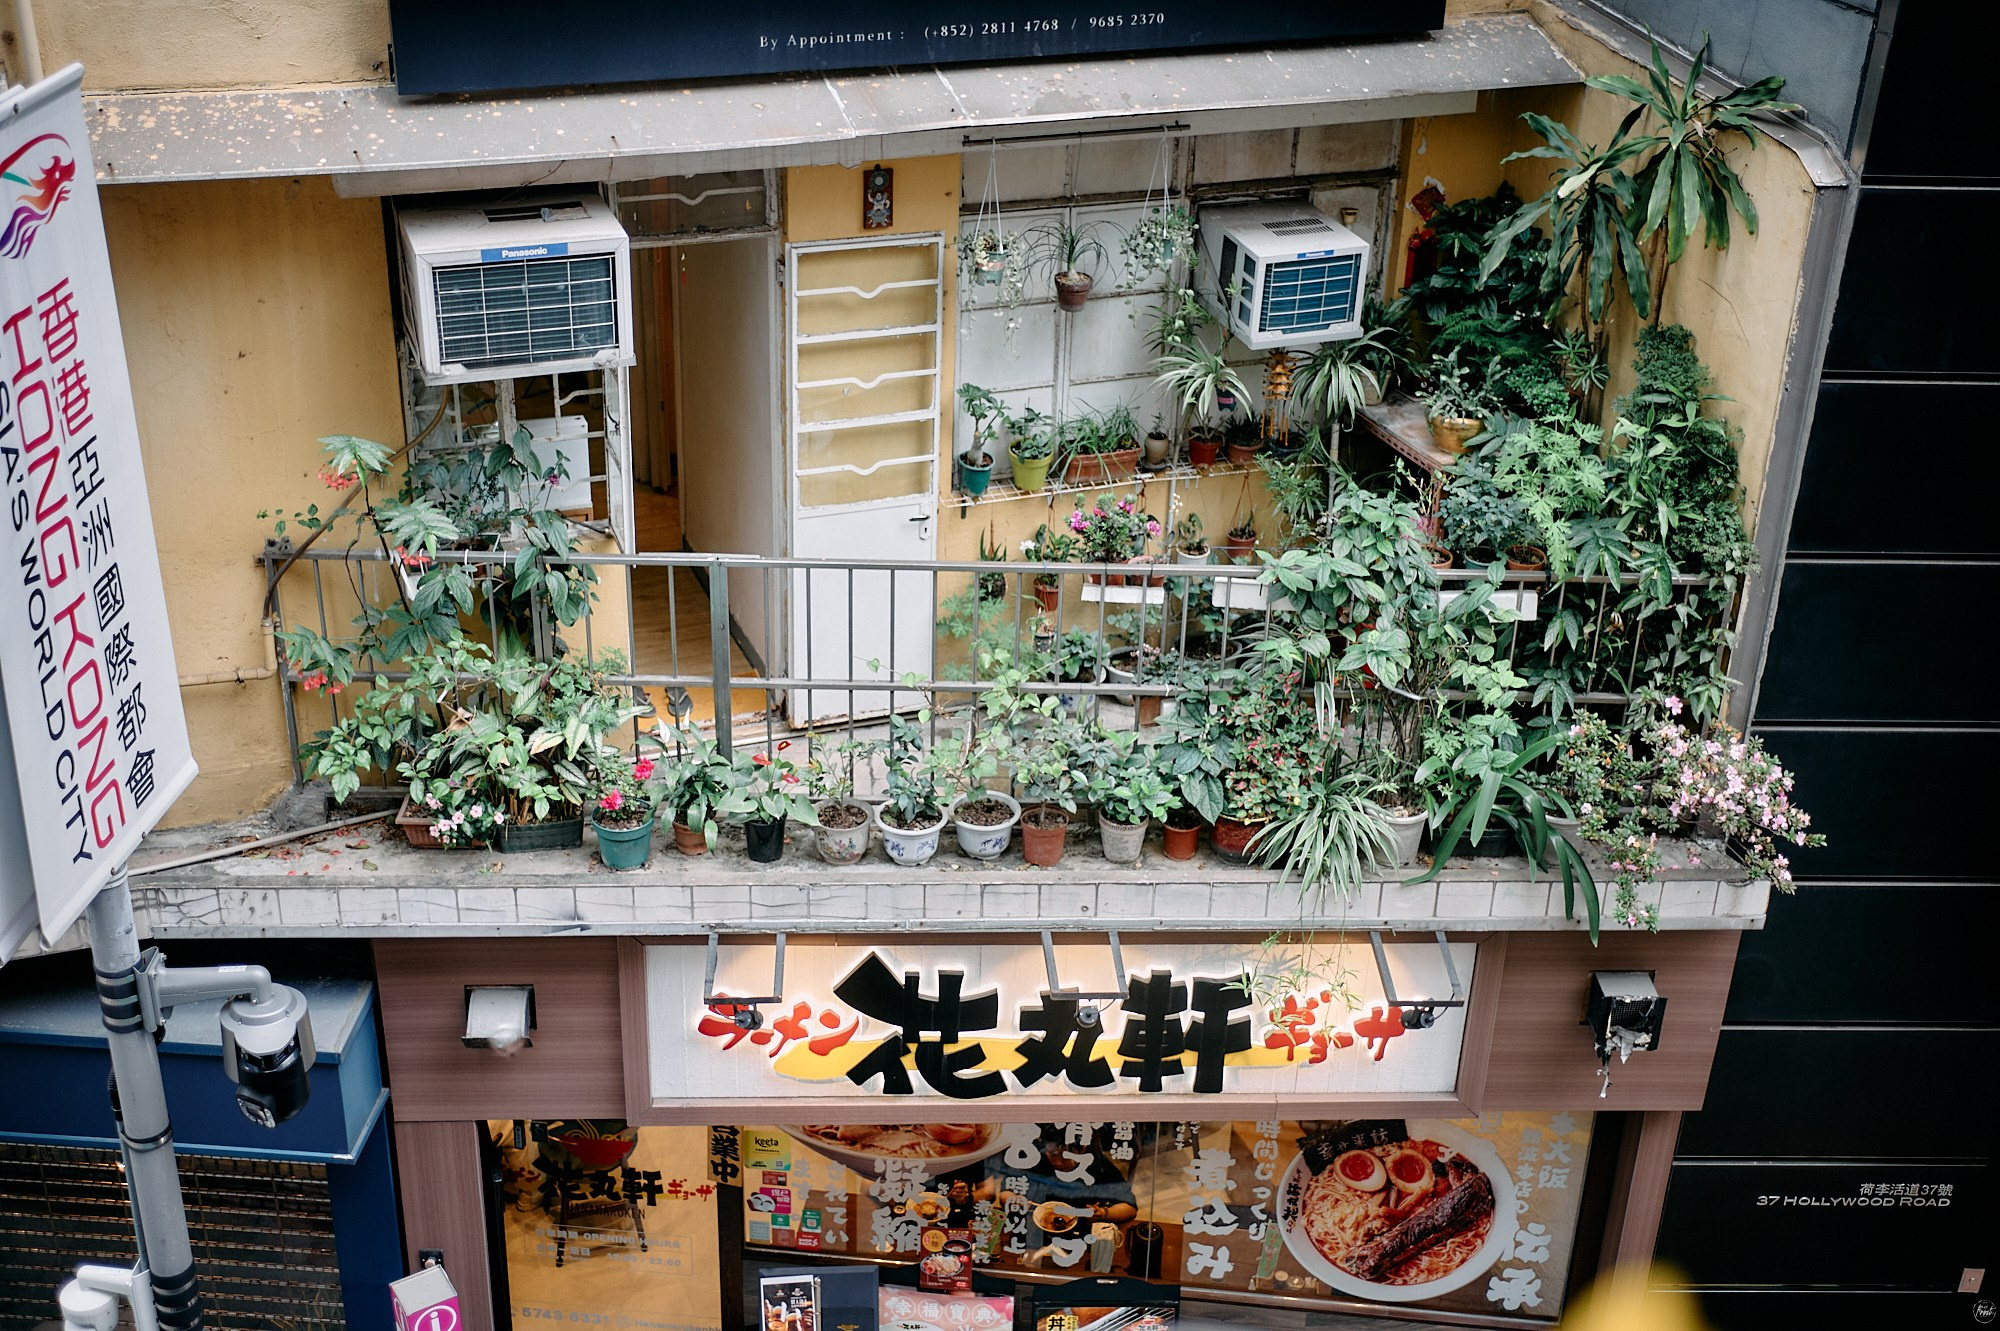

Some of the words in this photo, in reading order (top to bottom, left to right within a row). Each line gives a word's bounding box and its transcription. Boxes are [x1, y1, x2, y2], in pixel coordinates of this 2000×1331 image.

[760, 35, 778, 51] By
[787, 31, 893, 49] Appointment
[924, 25, 974, 40] (+852)
[981, 22, 1016, 36] 2811
[1023, 19, 1060, 33] 4768
[1089, 15, 1124, 29] 9685
[1130, 13, 1165, 27] 2370
[501, 246, 548, 259] Panasonic
[2, 304, 81, 589] HONG
[53, 591, 127, 849] KONG
[20, 536, 66, 742] WORLD
[55, 748, 94, 865] CITY
[698, 991, 861, 1059] ラーメン
[836, 951, 1253, 1100] 花丸軒
[754, 1136, 779, 1147] keeta
[531, 1157, 663, 1207] 花丸軒
[667, 1178, 718, 1202] ギョーザ
[1859, 1183, 1954, 1197] 荷李活道37號
[1182, 1147, 1240, 1280] 煮込み
[1756, 1196, 1781, 1207] 37
[1783, 1196, 1896, 1207] HOLLYWOOD
[1899, 1197, 1951, 1207] ROAD
[583, 1232, 636, 1246] OPENING
[895, 1300, 993, 1324] 幸福寶典
[1048, 1316, 1066, 1331] 丼
